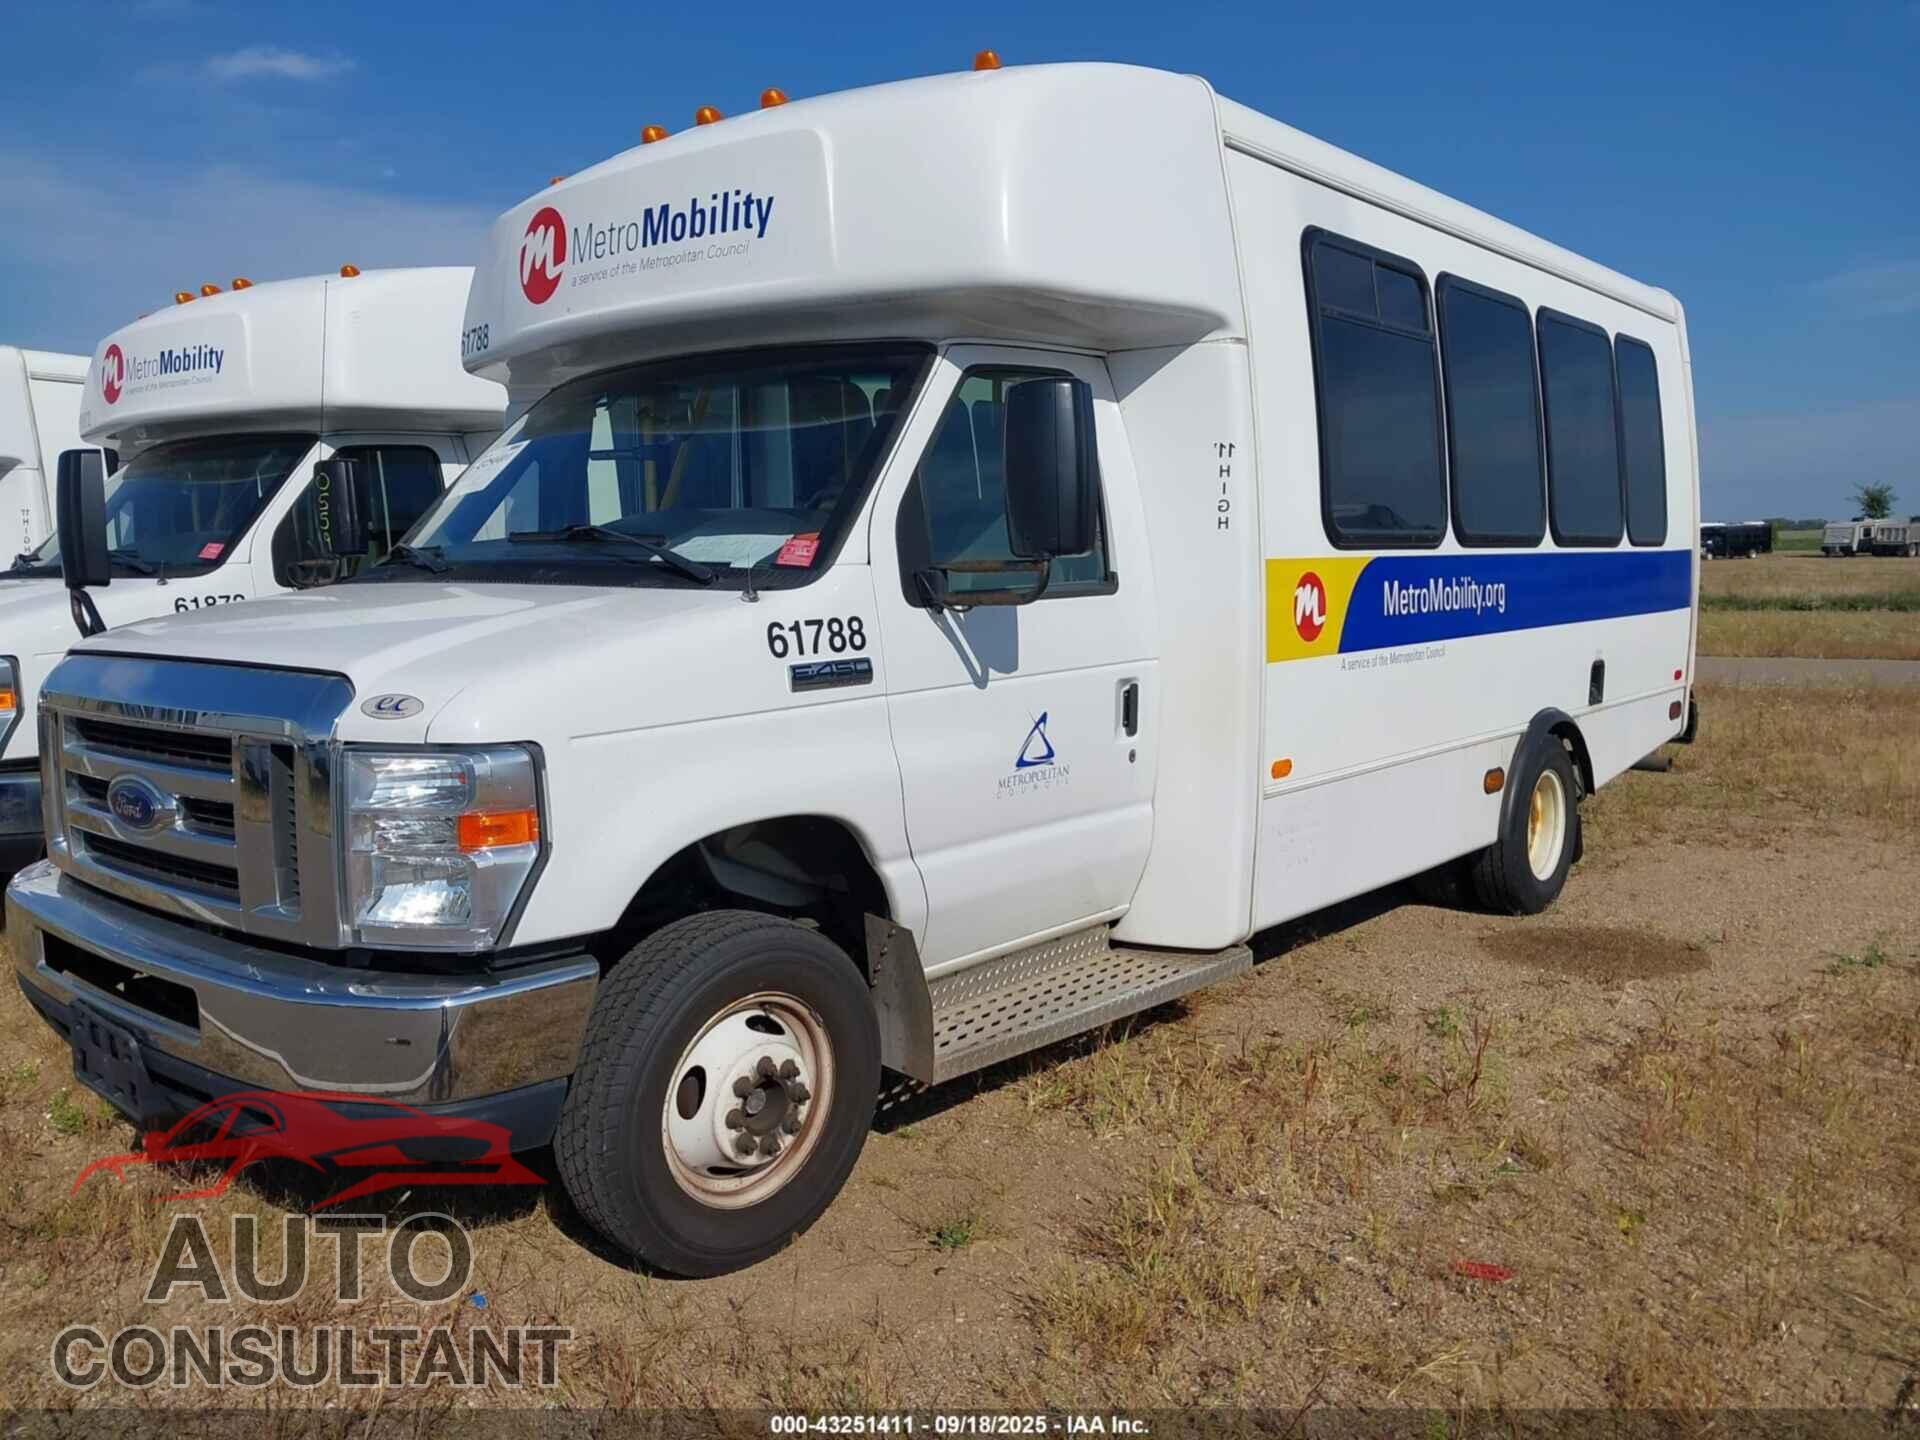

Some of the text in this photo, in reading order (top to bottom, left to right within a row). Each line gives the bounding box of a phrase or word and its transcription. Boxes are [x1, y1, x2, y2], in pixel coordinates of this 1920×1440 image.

[572, 189, 774, 265] MetroMobility
[639, 248, 704, 272] Metropolitan
[706, 239, 750, 260] Council
[126, 344, 224, 384] MetroMobility
[1383, 576, 1506, 617] MetroMobility.org
[767, 616, 866, 658] 61788
[998, 764, 1071, 789] METROPOLITAN
